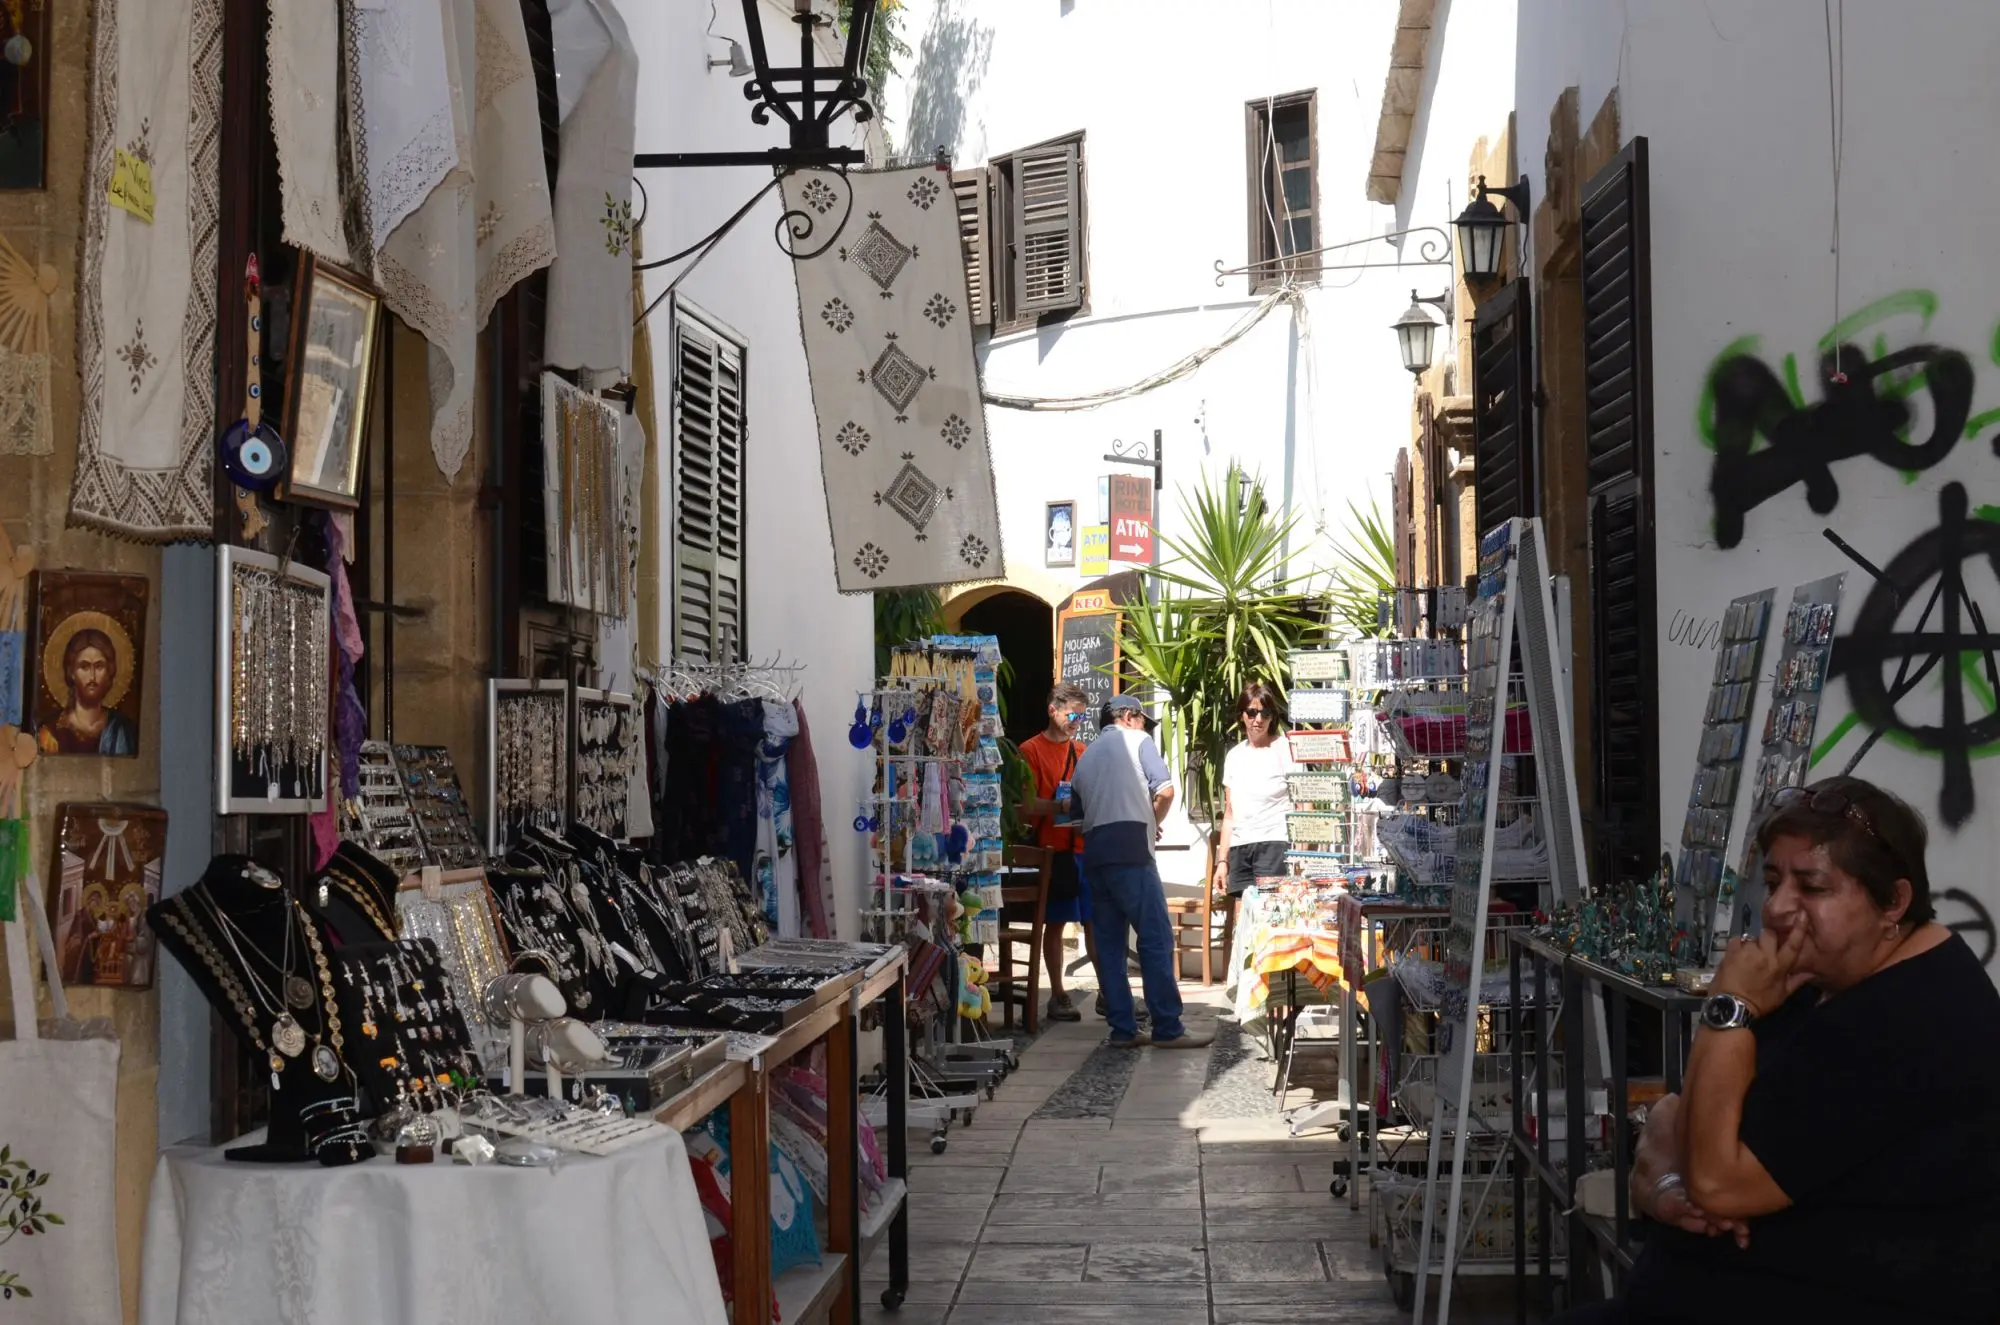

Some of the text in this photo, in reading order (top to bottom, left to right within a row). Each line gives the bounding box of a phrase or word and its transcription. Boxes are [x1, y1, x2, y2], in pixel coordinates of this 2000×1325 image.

[1115, 518, 1149, 539] ATM
[1083, 533, 1107, 546] ATM
[1075, 597, 1103, 609] KEO
[1064, 636, 1101, 652] MOUSAKA
[1062, 662, 1090, 678] KEBAB
